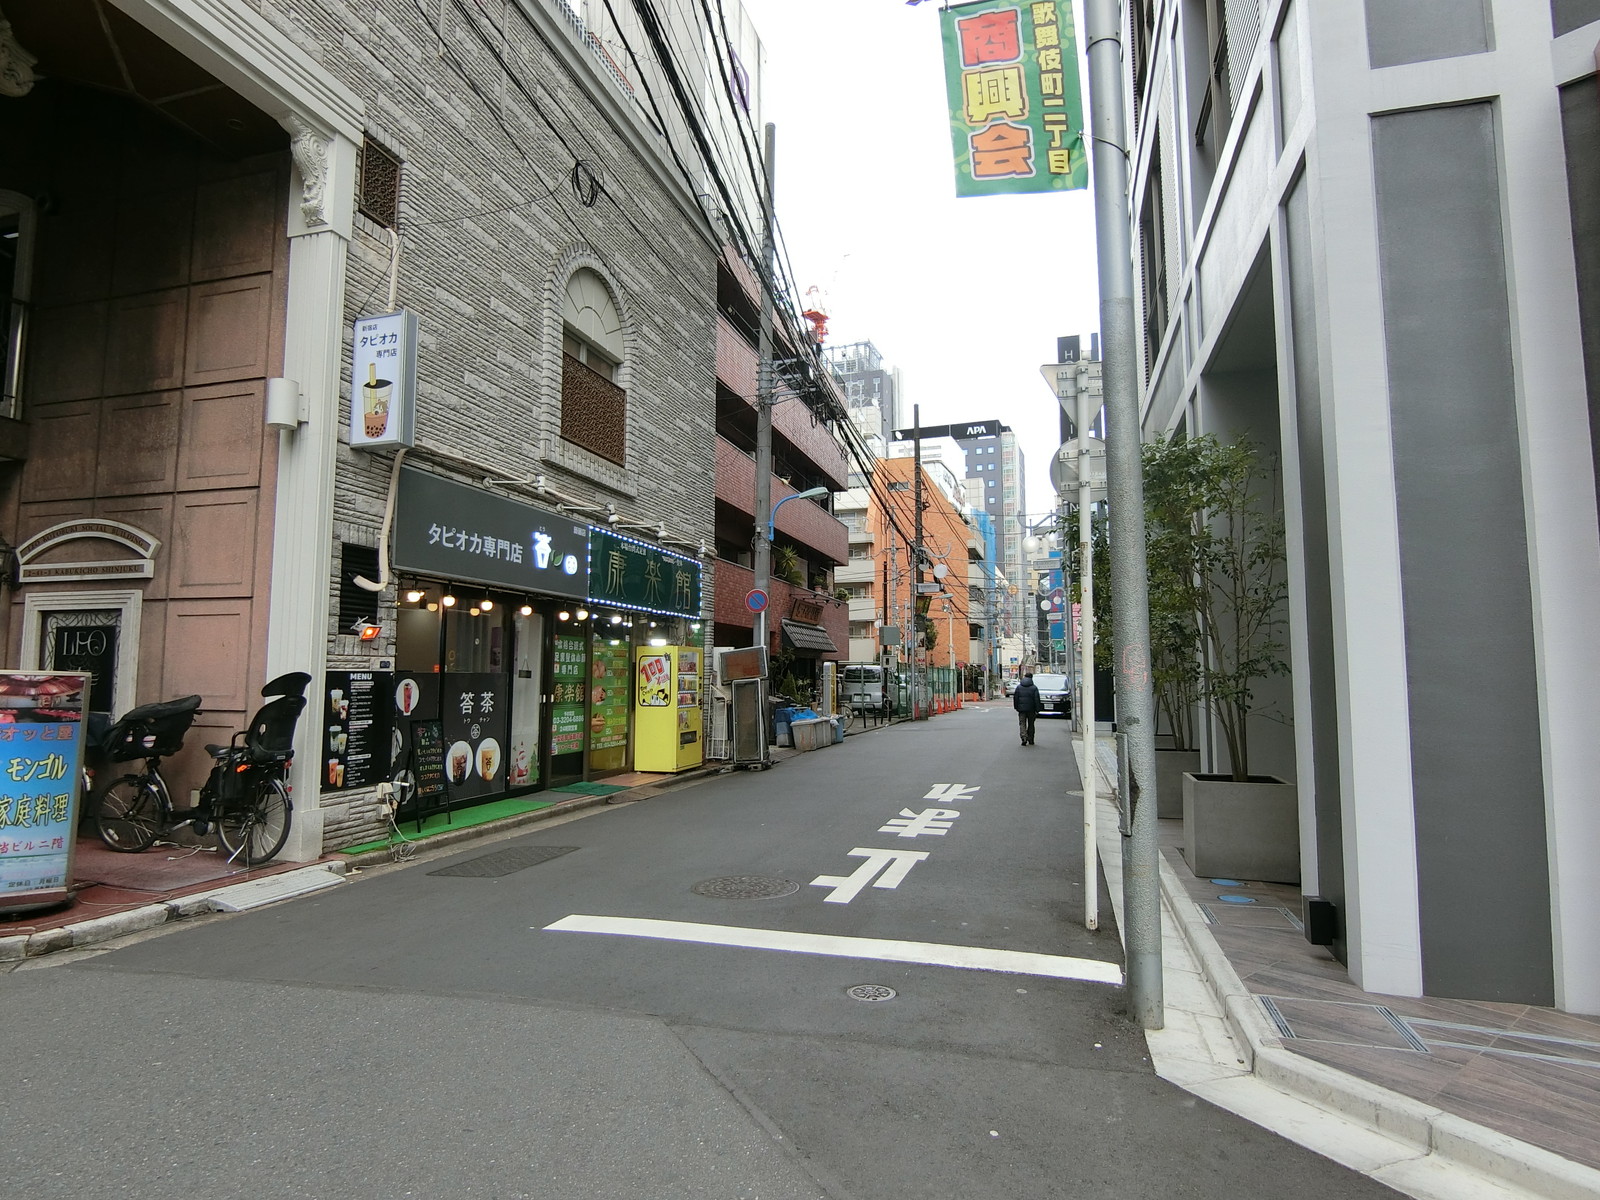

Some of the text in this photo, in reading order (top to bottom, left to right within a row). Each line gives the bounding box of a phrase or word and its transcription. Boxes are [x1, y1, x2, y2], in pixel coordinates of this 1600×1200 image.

[1030, 2, 1072, 175] 歌舞伎町二丁目
[360, 333, 398, 347] タピオカ
[376, 348, 398, 358] 専門店
[966, 425, 987, 435] APA
[428, 522, 524, 564] タピオカ専門店
[63, 629, 107, 657] LEO
[349, 673, 373, 681] MENU
[0, 724, 74, 743] オッと屋
[6, 753, 69, 782] モンゴル
[0, 792, 70, 829] 家庭料理
